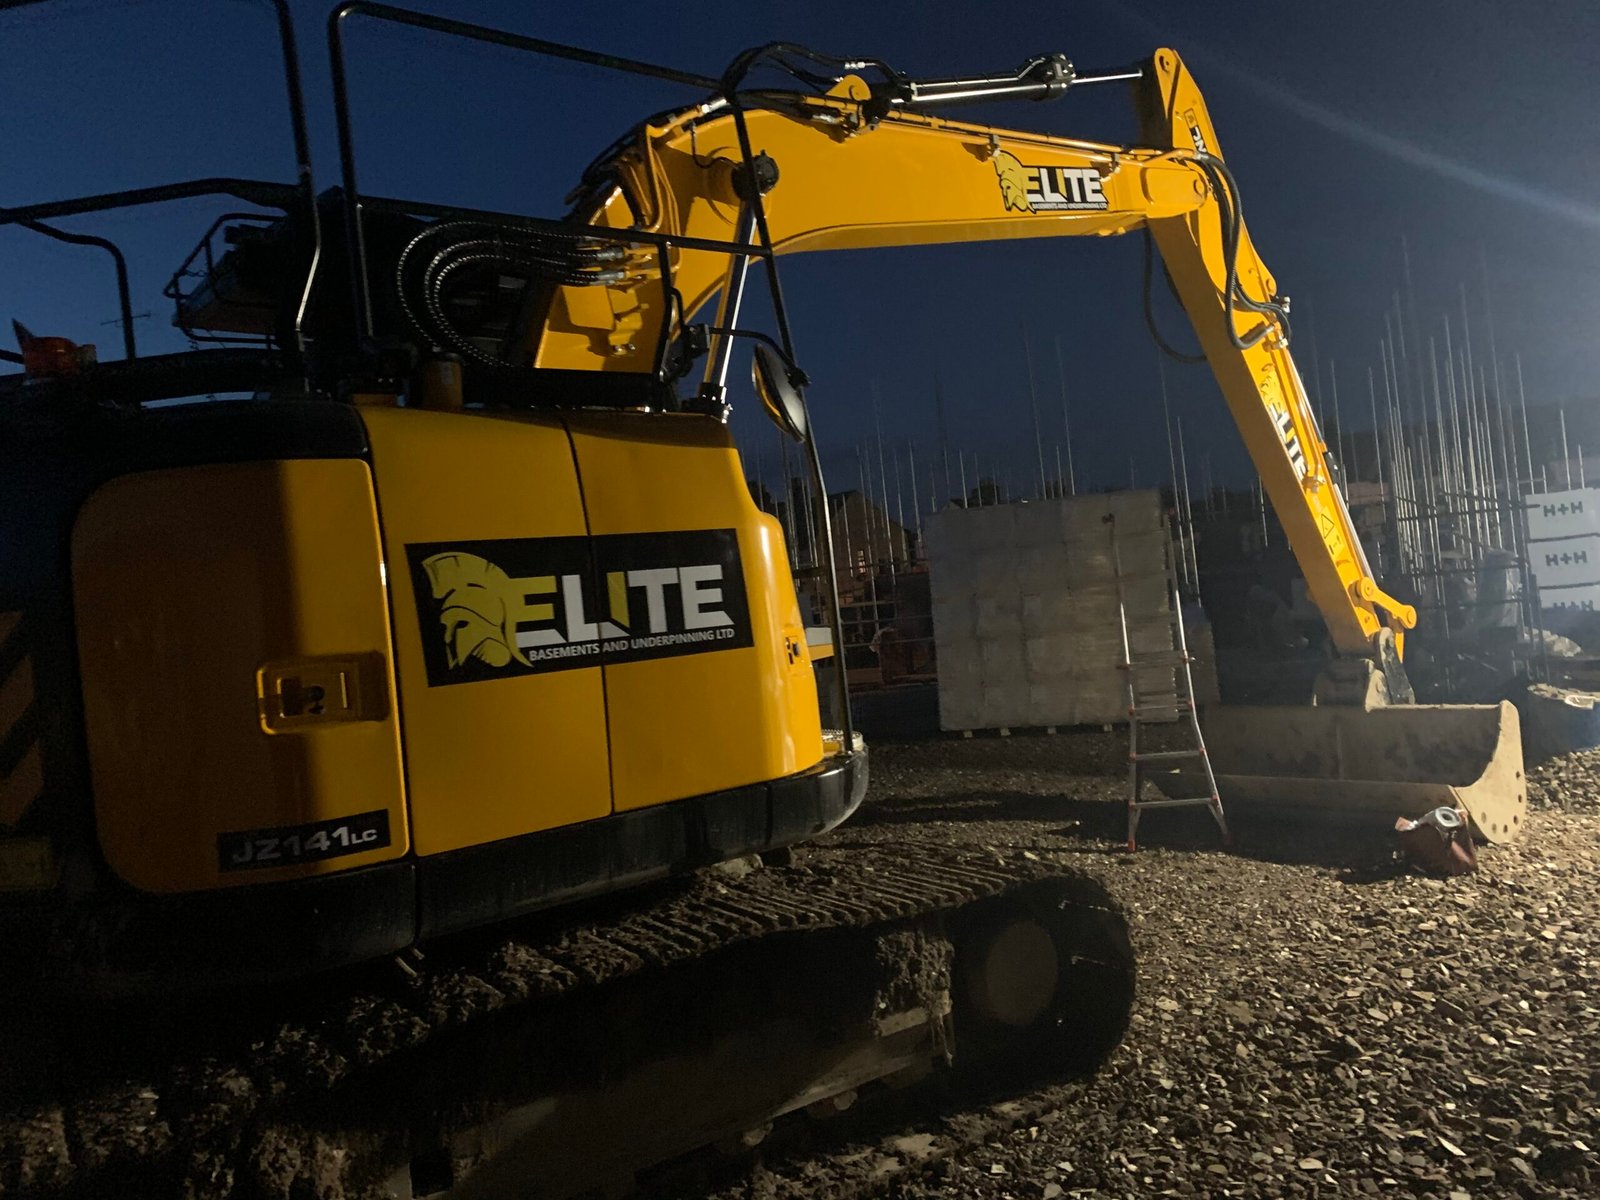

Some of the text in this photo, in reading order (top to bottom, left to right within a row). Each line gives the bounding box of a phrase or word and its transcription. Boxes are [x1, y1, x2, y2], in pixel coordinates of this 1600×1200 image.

[1026, 167, 1108, 203] ELITE
[1543, 501, 1583, 517] H+H
[1545, 551, 1588, 566] H+H
[513, 564, 735, 648] ELITE
[528, 627, 735, 661] BASEMENTS AND UNDERPINNING LTD
